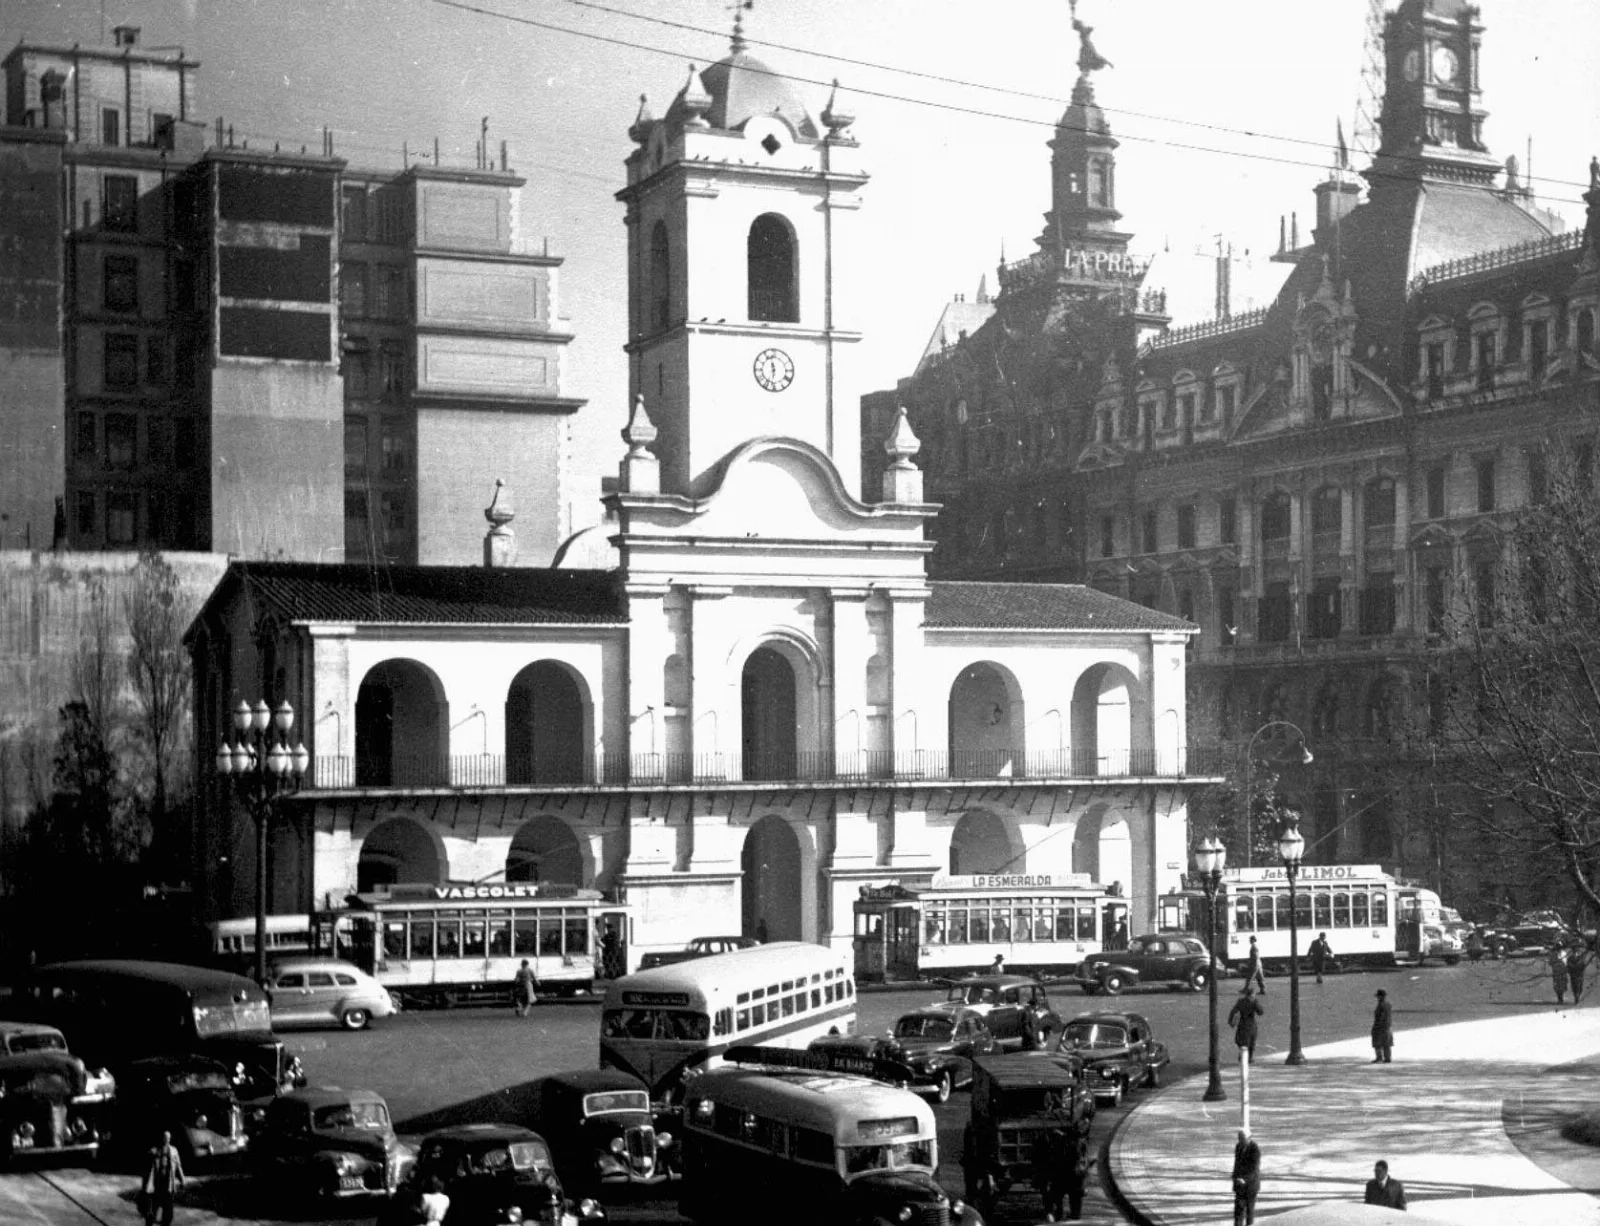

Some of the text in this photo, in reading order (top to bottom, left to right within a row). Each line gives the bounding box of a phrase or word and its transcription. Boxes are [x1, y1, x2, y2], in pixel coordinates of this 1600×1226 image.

[1300, 867, 1357, 879] LIMOL
[972, 876, 985, 887] LA
[988, 875, 1051, 887] ESMERALDA
[435, 885, 539, 898] VASCOLET
